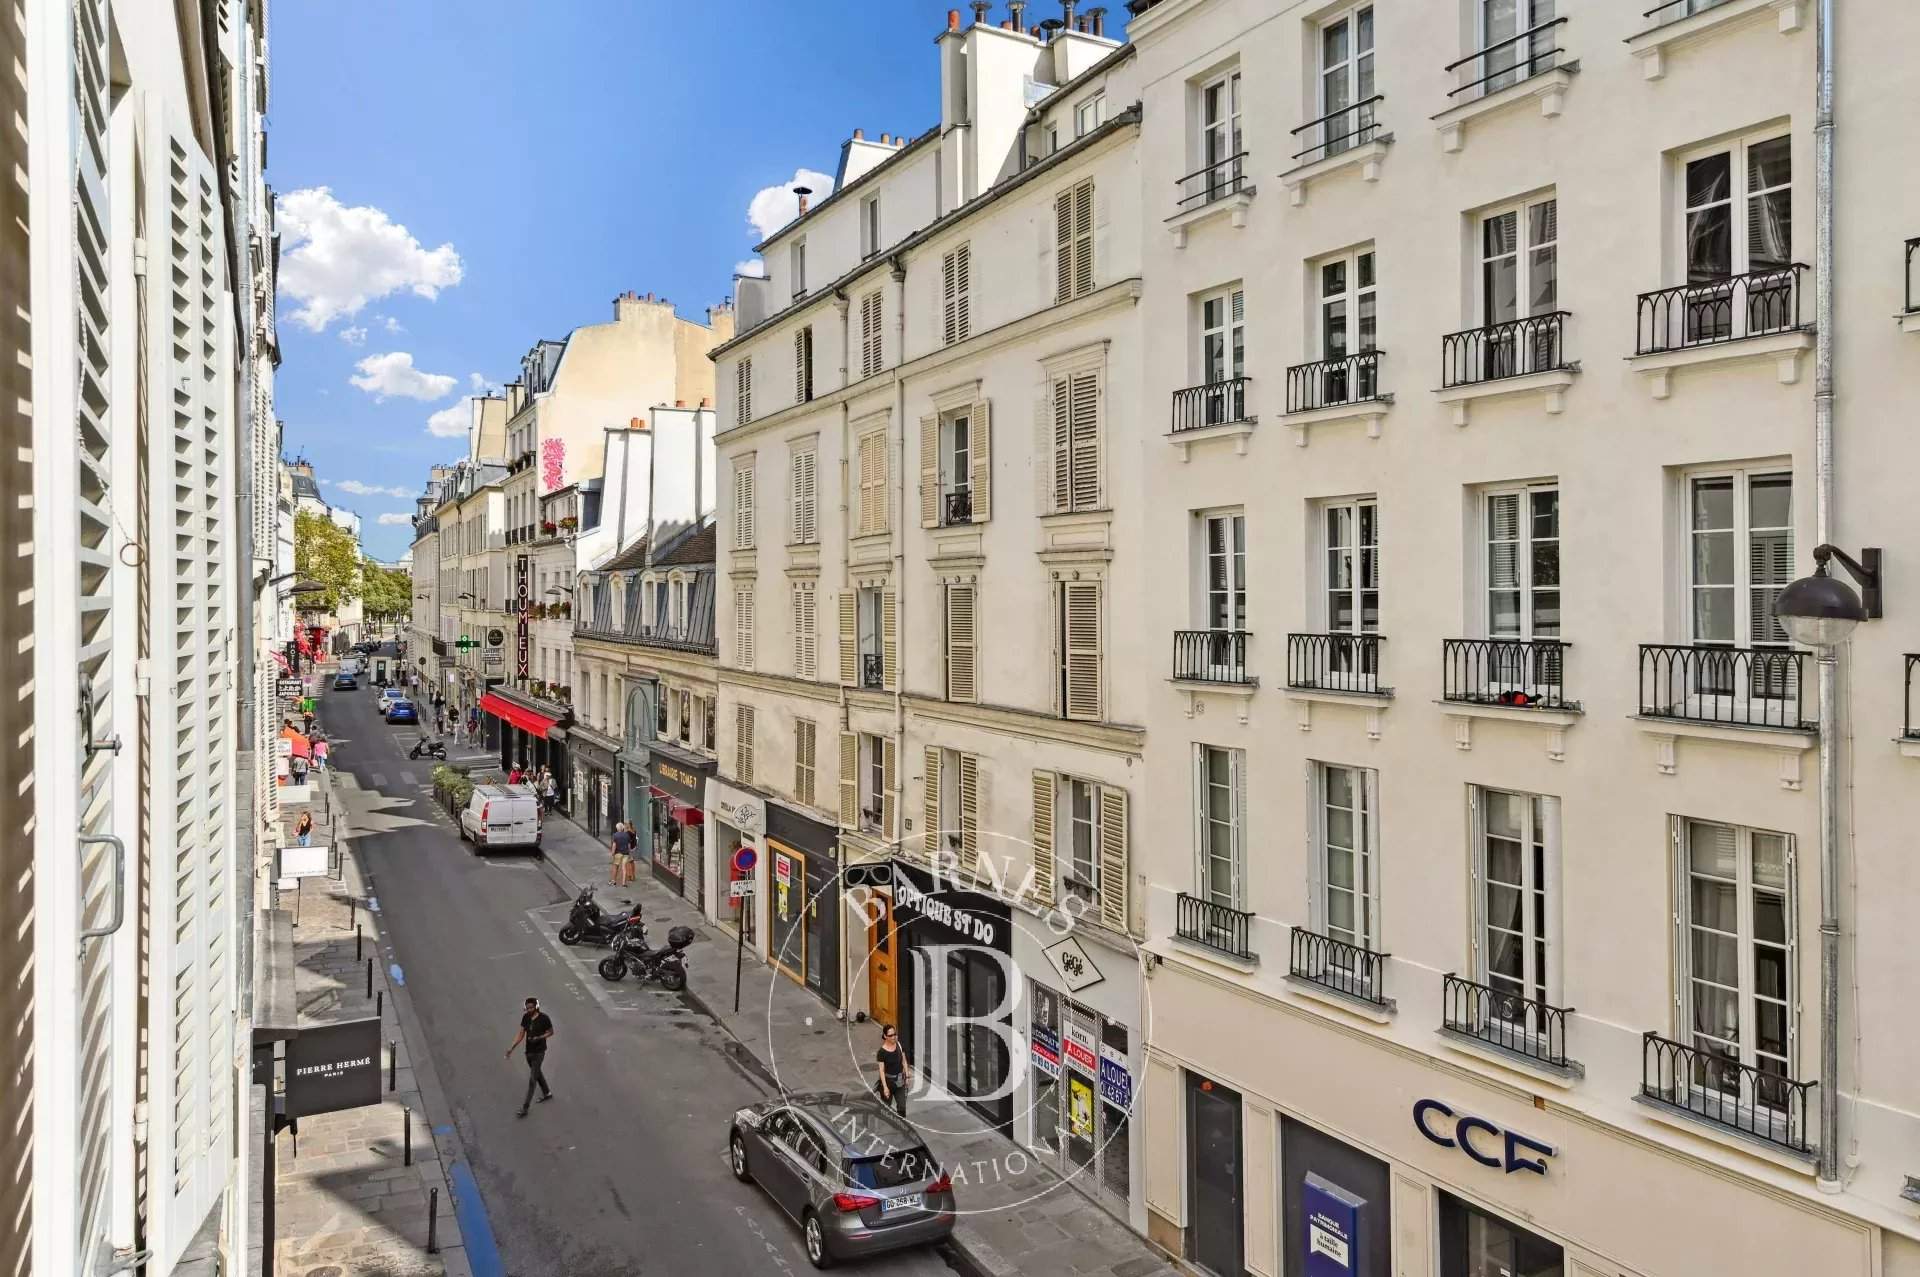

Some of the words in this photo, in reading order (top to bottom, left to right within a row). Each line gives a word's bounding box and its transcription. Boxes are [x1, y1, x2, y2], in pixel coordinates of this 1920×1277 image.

[518, 558, 528, 676] THOUMIEUX
[898, 886, 952, 928] OPTIQUE
[953, 909, 972, 935] ST
[973, 920, 994, 945] DO
[296, 1063, 333, 1076] PIERRE
[336, 1056, 371, 1070] HERMÉ
[1074, 1047, 1093, 1066] LOUER
[1413, 1098, 1556, 1176] CCF
[1316, 1238, 1342, 1257] humaine
